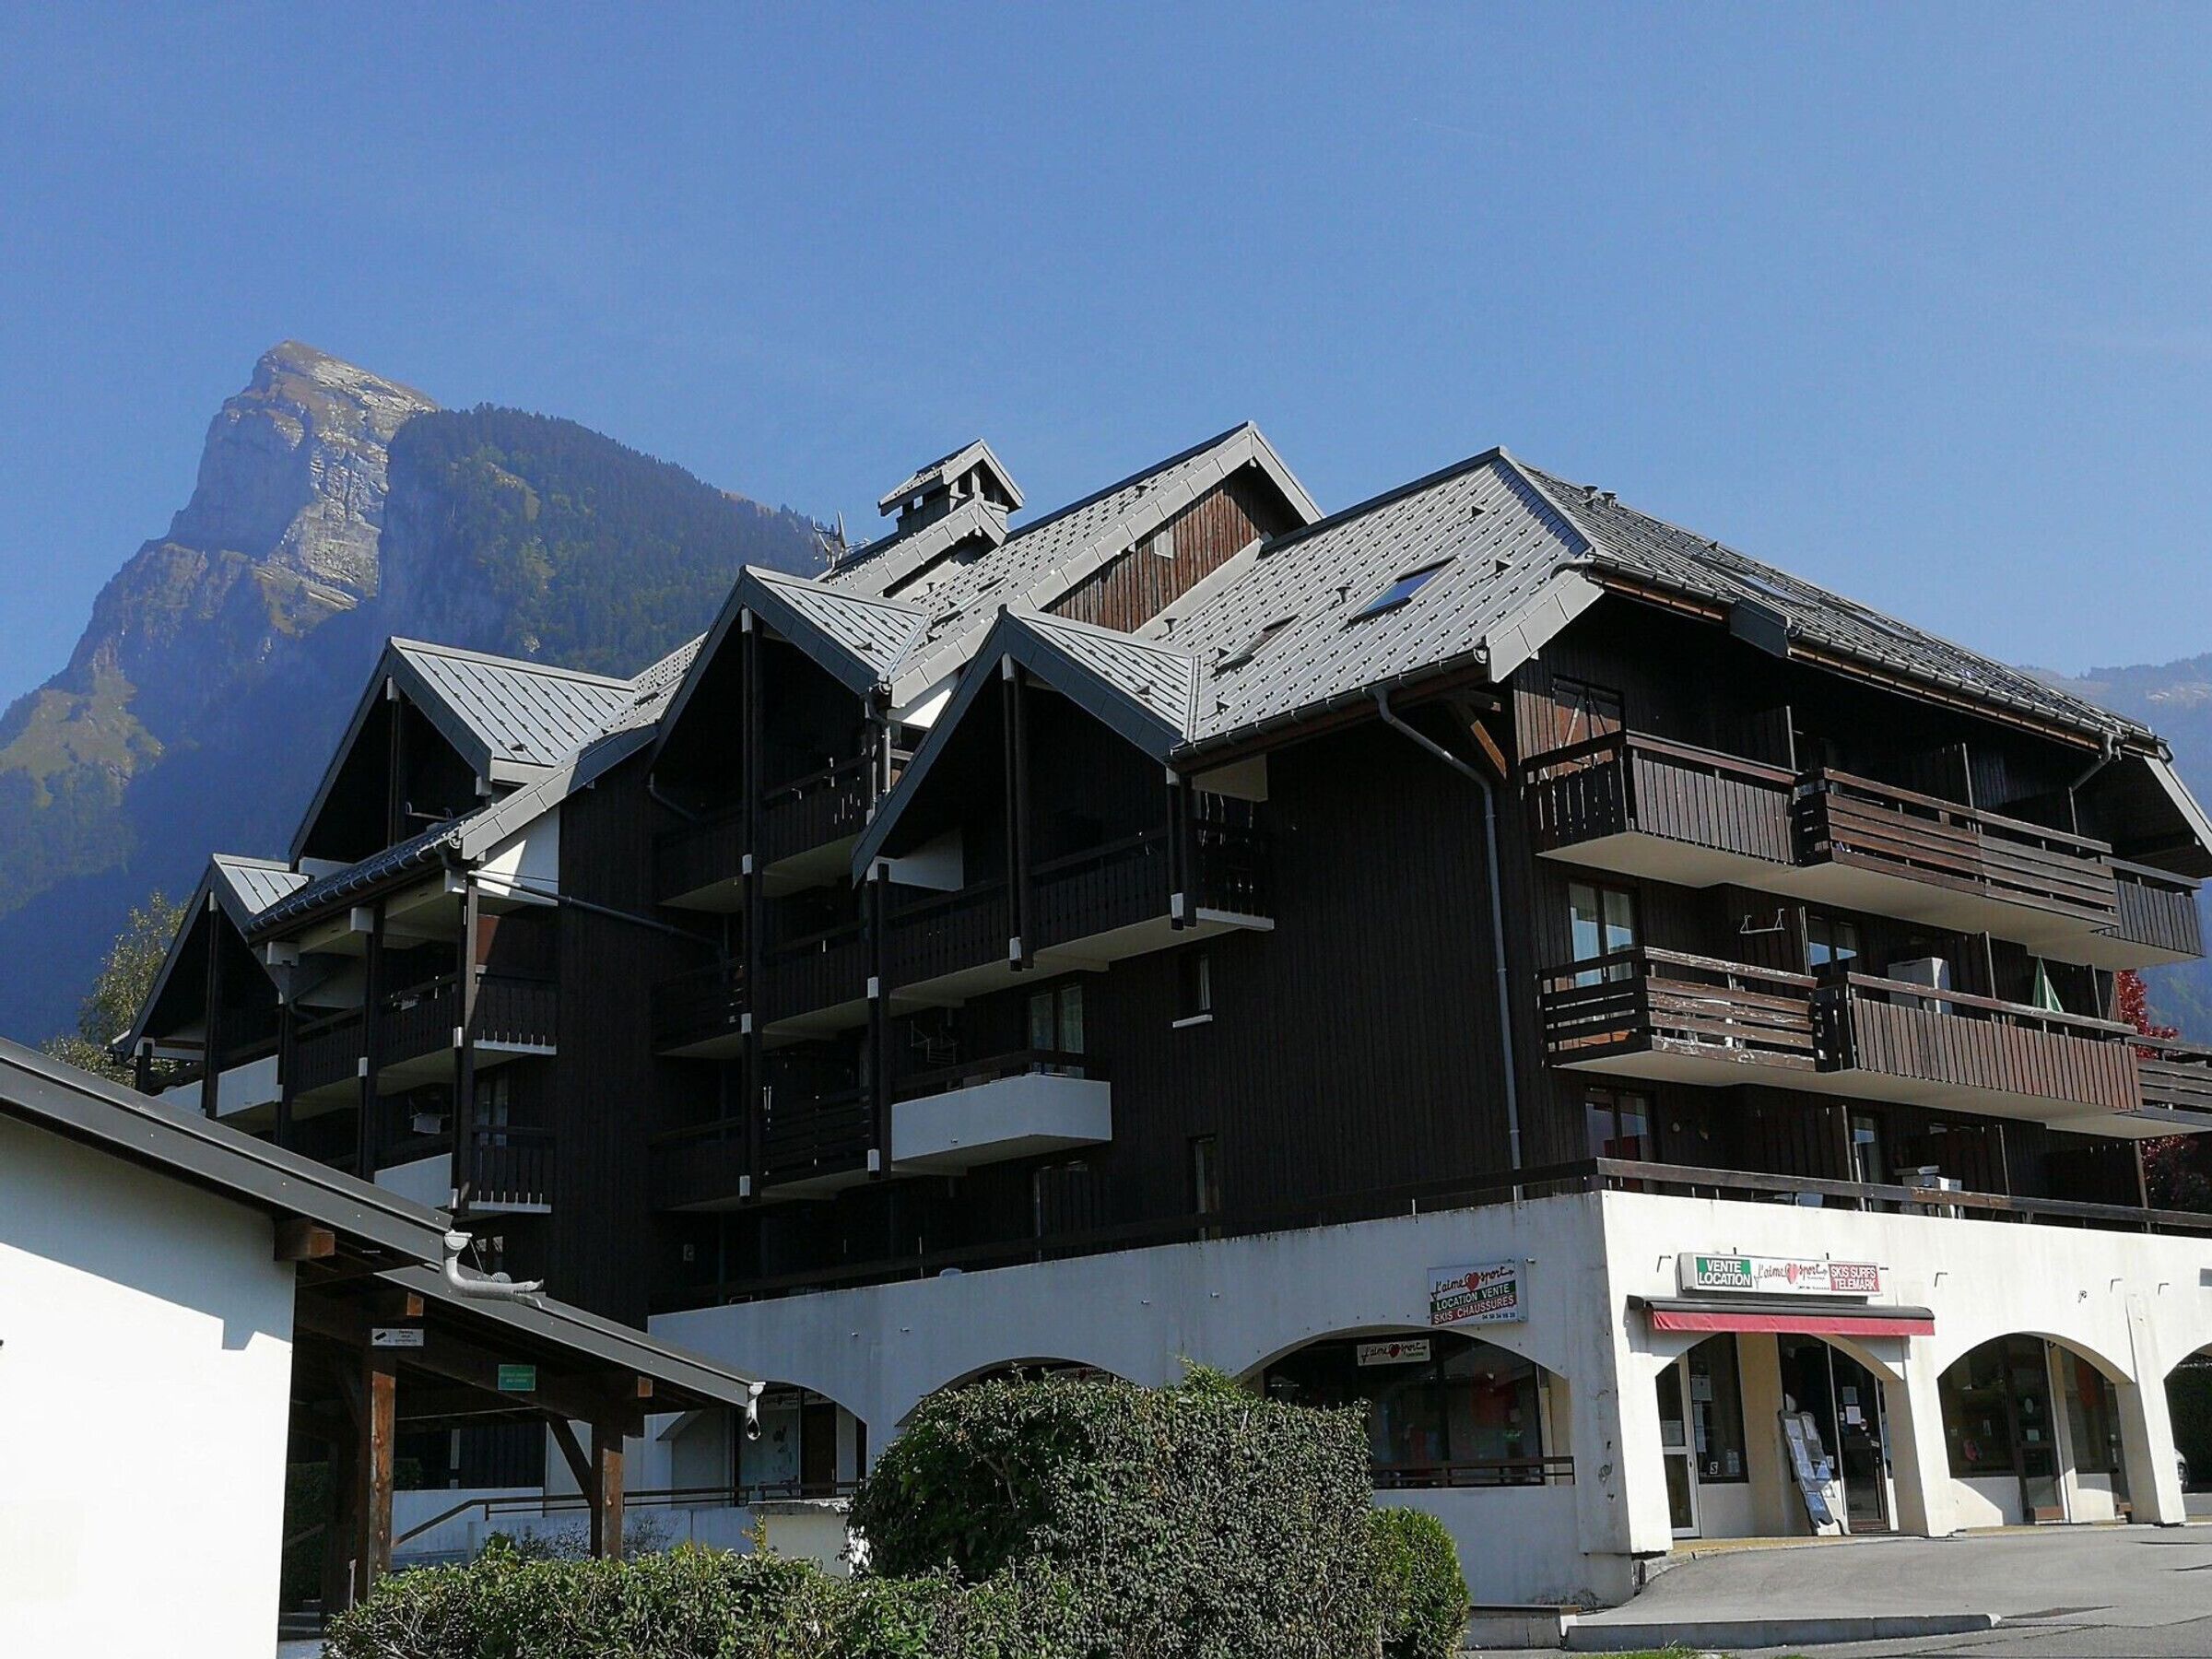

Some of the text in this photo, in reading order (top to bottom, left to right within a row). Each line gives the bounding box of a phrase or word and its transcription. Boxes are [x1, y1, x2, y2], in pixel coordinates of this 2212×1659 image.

[1706, 1259, 1742, 1273] VENTE
[1799, 1264, 1828, 1280] sport
[1830, 1265, 1876, 1279] SKIS SURFS
[1479, 1265, 1514, 1285] sport
[1699, 1272, 1751, 1286] LOCATION
[1834, 1277, 1876, 1290] TELEMARK
[1436, 1283, 1511, 1311] LOCATION VENTE
[1434, 1295, 1514, 1324] SKIS CHAUSSURES
